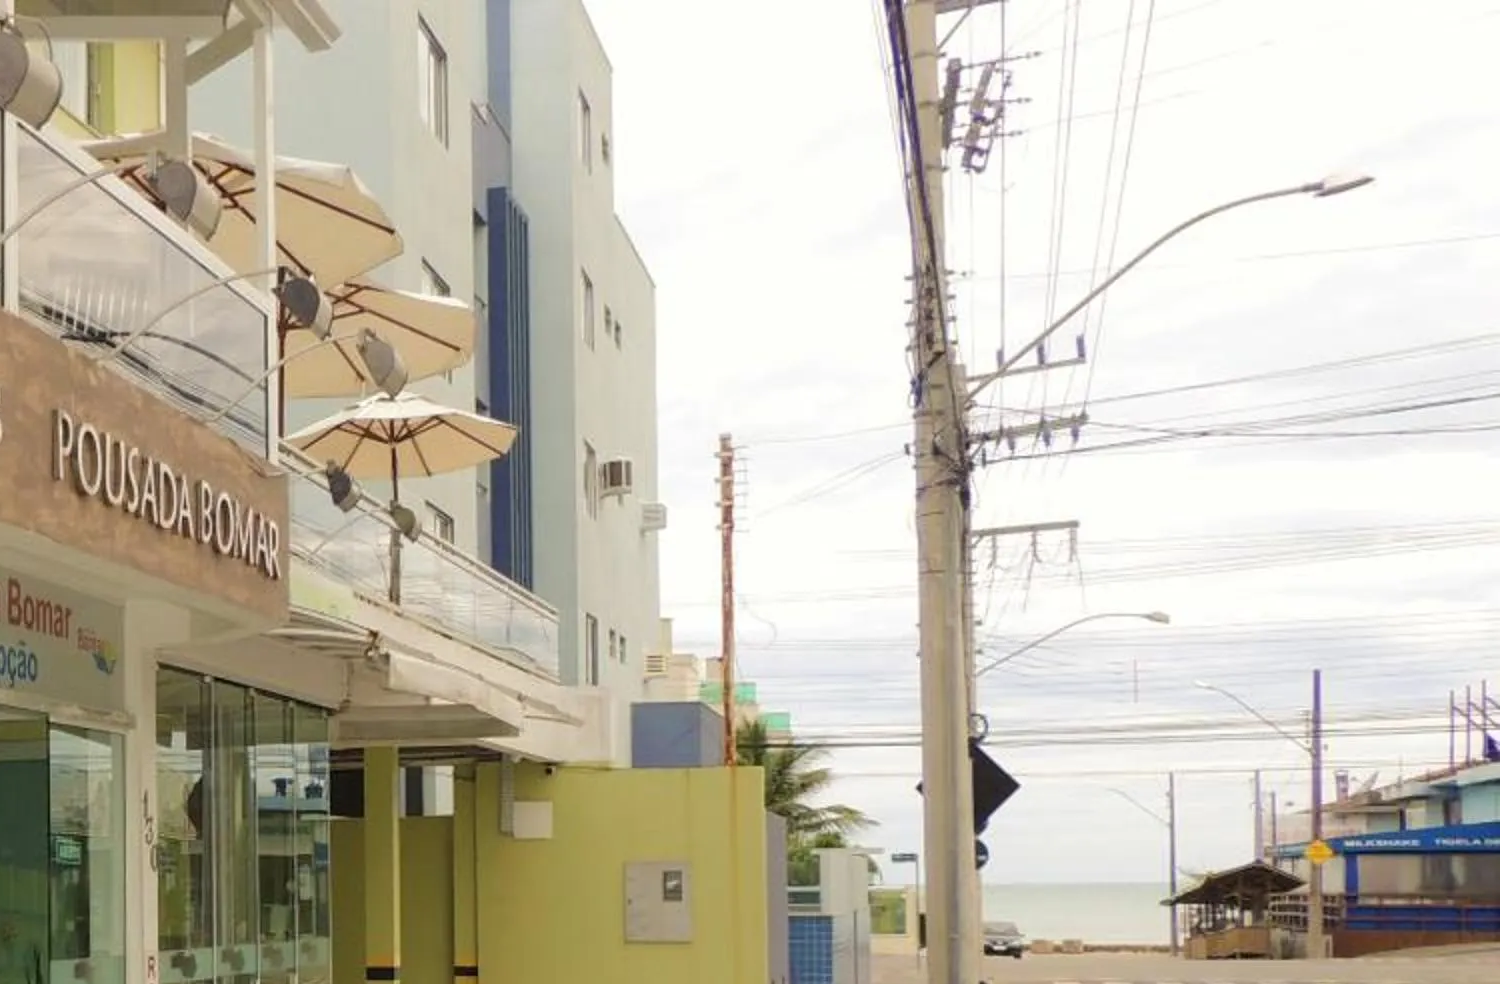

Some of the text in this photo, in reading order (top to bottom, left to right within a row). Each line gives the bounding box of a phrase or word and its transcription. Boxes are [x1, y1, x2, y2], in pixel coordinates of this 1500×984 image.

[55, 408, 281, 581] POUSADA BOMAR
[7, 577, 73, 641] Bomar
